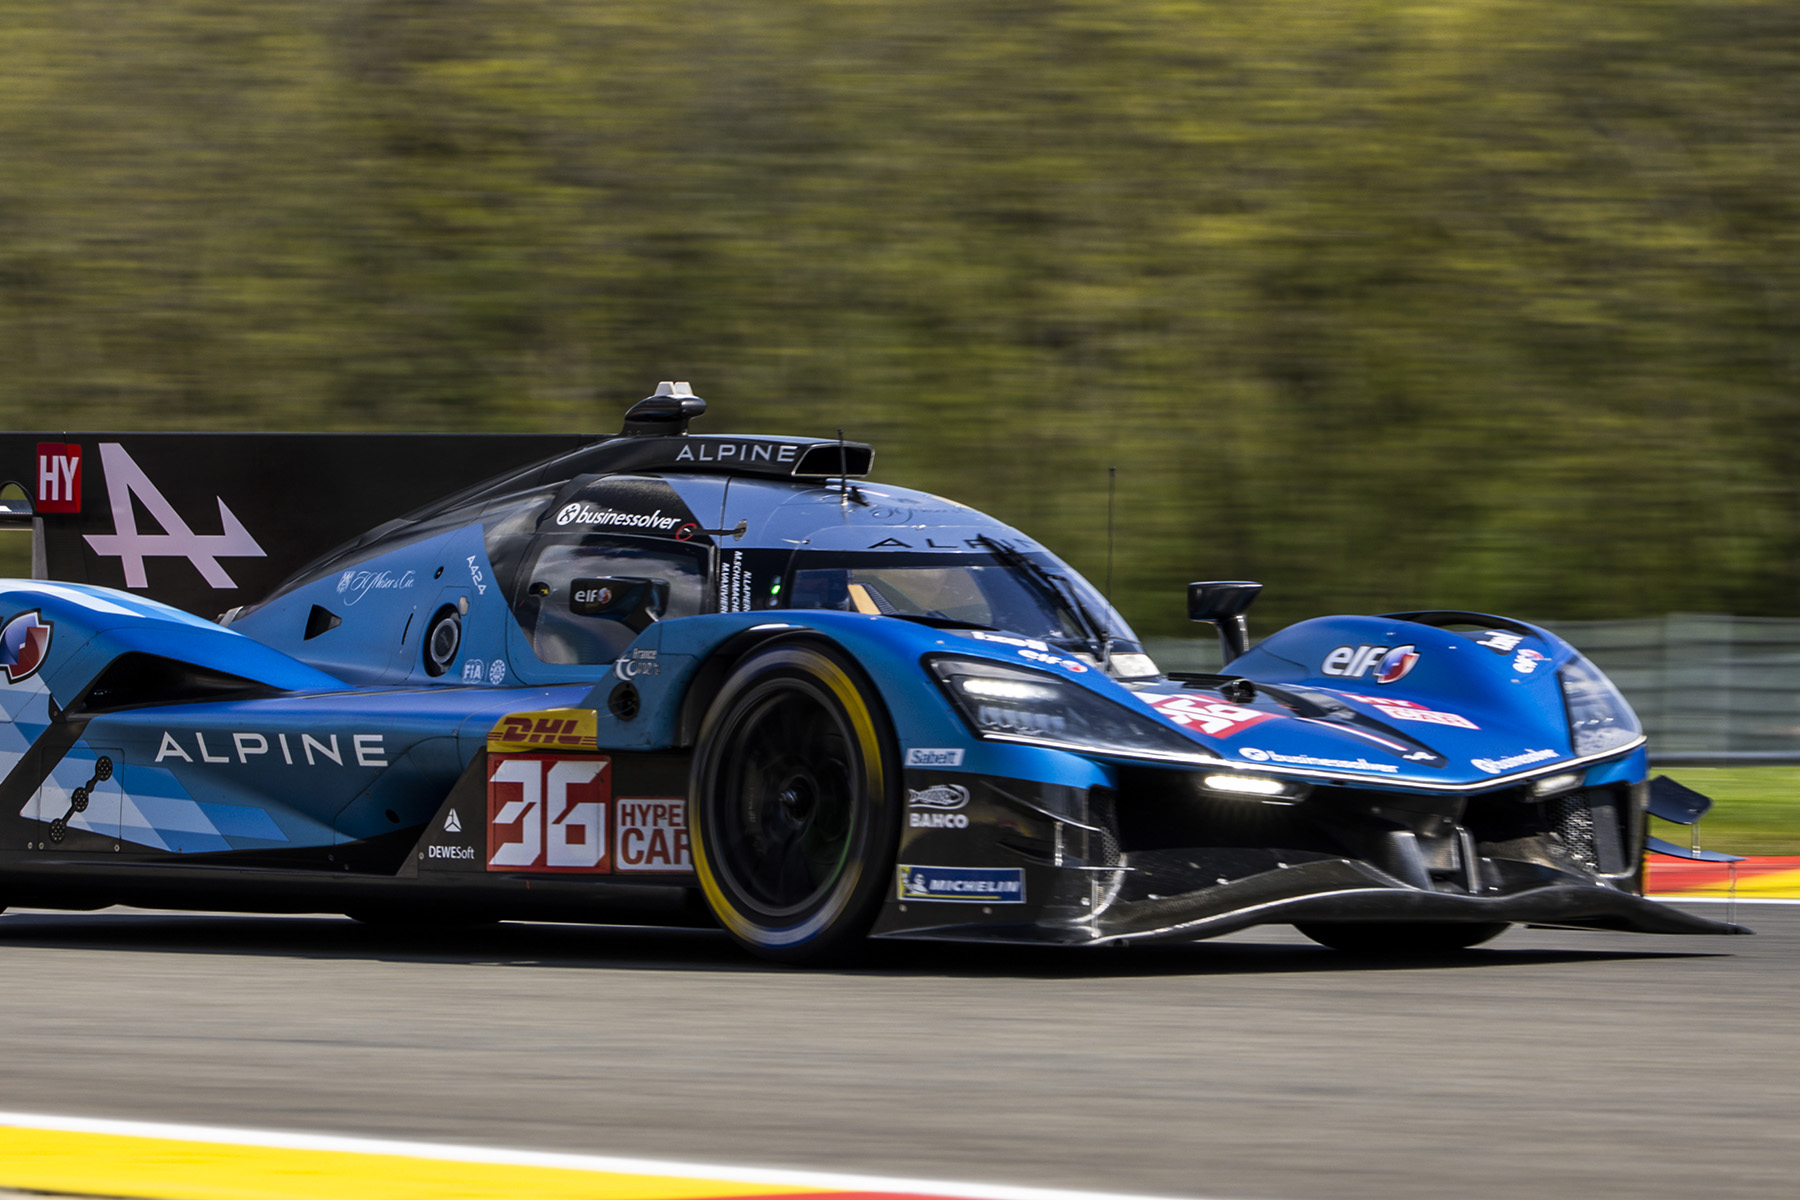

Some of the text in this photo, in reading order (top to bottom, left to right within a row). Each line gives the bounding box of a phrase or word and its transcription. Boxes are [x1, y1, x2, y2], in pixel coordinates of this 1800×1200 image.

[675, 444, 799, 462] ALPINE
[39, 455, 79, 501] HY
[575, 504, 682, 530] businessolver
[466, 554, 487, 595] A424
[574, 588, 599, 603] elf
[1321, 644, 1388, 677] elf
[502, 716, 583, 745] DHL
[154, 730, 389, 768] ALPINE
[911, 750, 958, 765] Sabelt
[488, 759, 610, 867] 36
[621, 803, 687, 827] HYPE
[909, 812, 969, 829] BAHCO
[428, 845, 475, 860] DEWESoft
[621, 827, 694, 866] CAR
[929, 878, 1021, 893] MICHELIN
